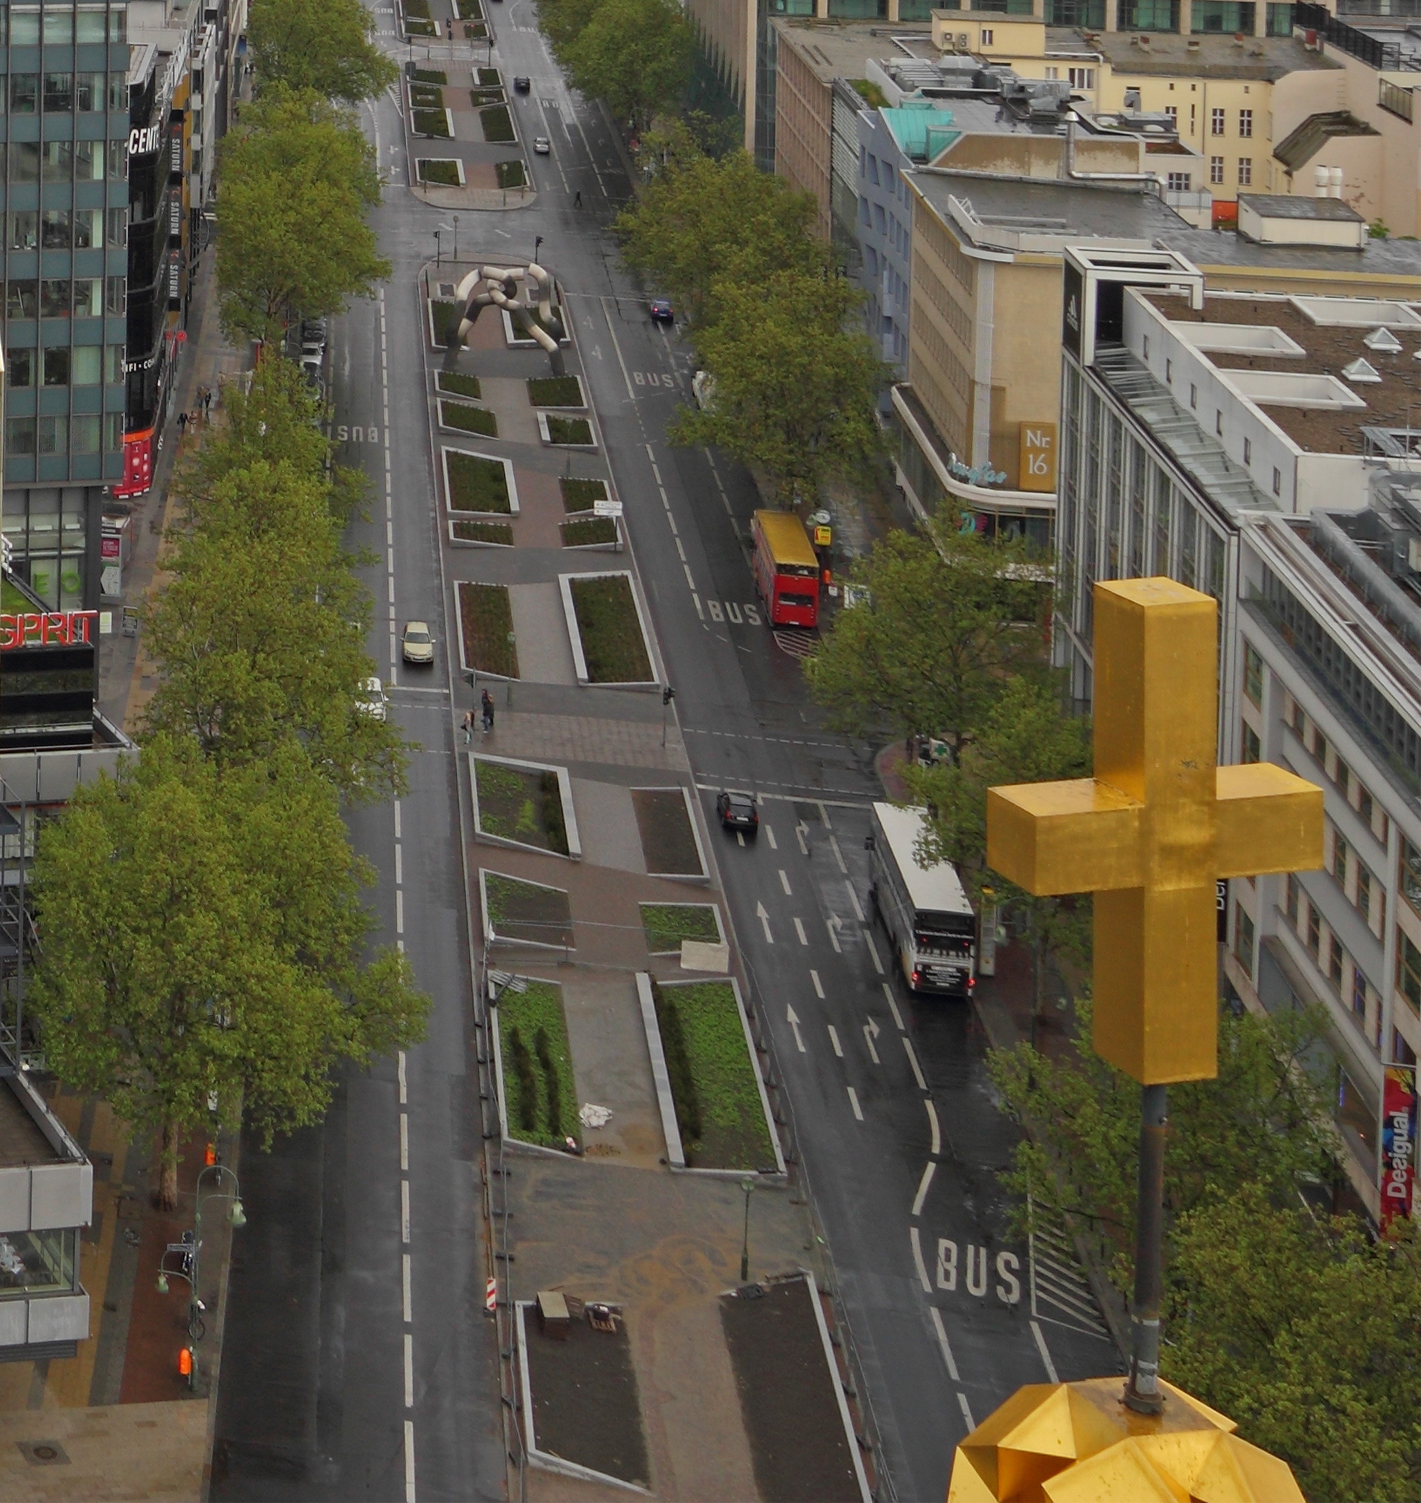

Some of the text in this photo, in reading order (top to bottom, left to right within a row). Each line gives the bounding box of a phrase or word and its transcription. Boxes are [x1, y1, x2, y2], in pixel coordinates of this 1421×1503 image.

[171, 138, 181, 172] SATURN
[170, 201, 180, 235] SATURN
[169, 264, 179, 298] SATURN
[633, 371, 675, 388] BUS
[337, 425, 379, 443] BUS
[1028, 453, 1048, 475] 16
[0, 609, 99, 651] SPRIT
[707, 600, 761, 626] BUS
[936, 1237, 1020, 1305] BUS
